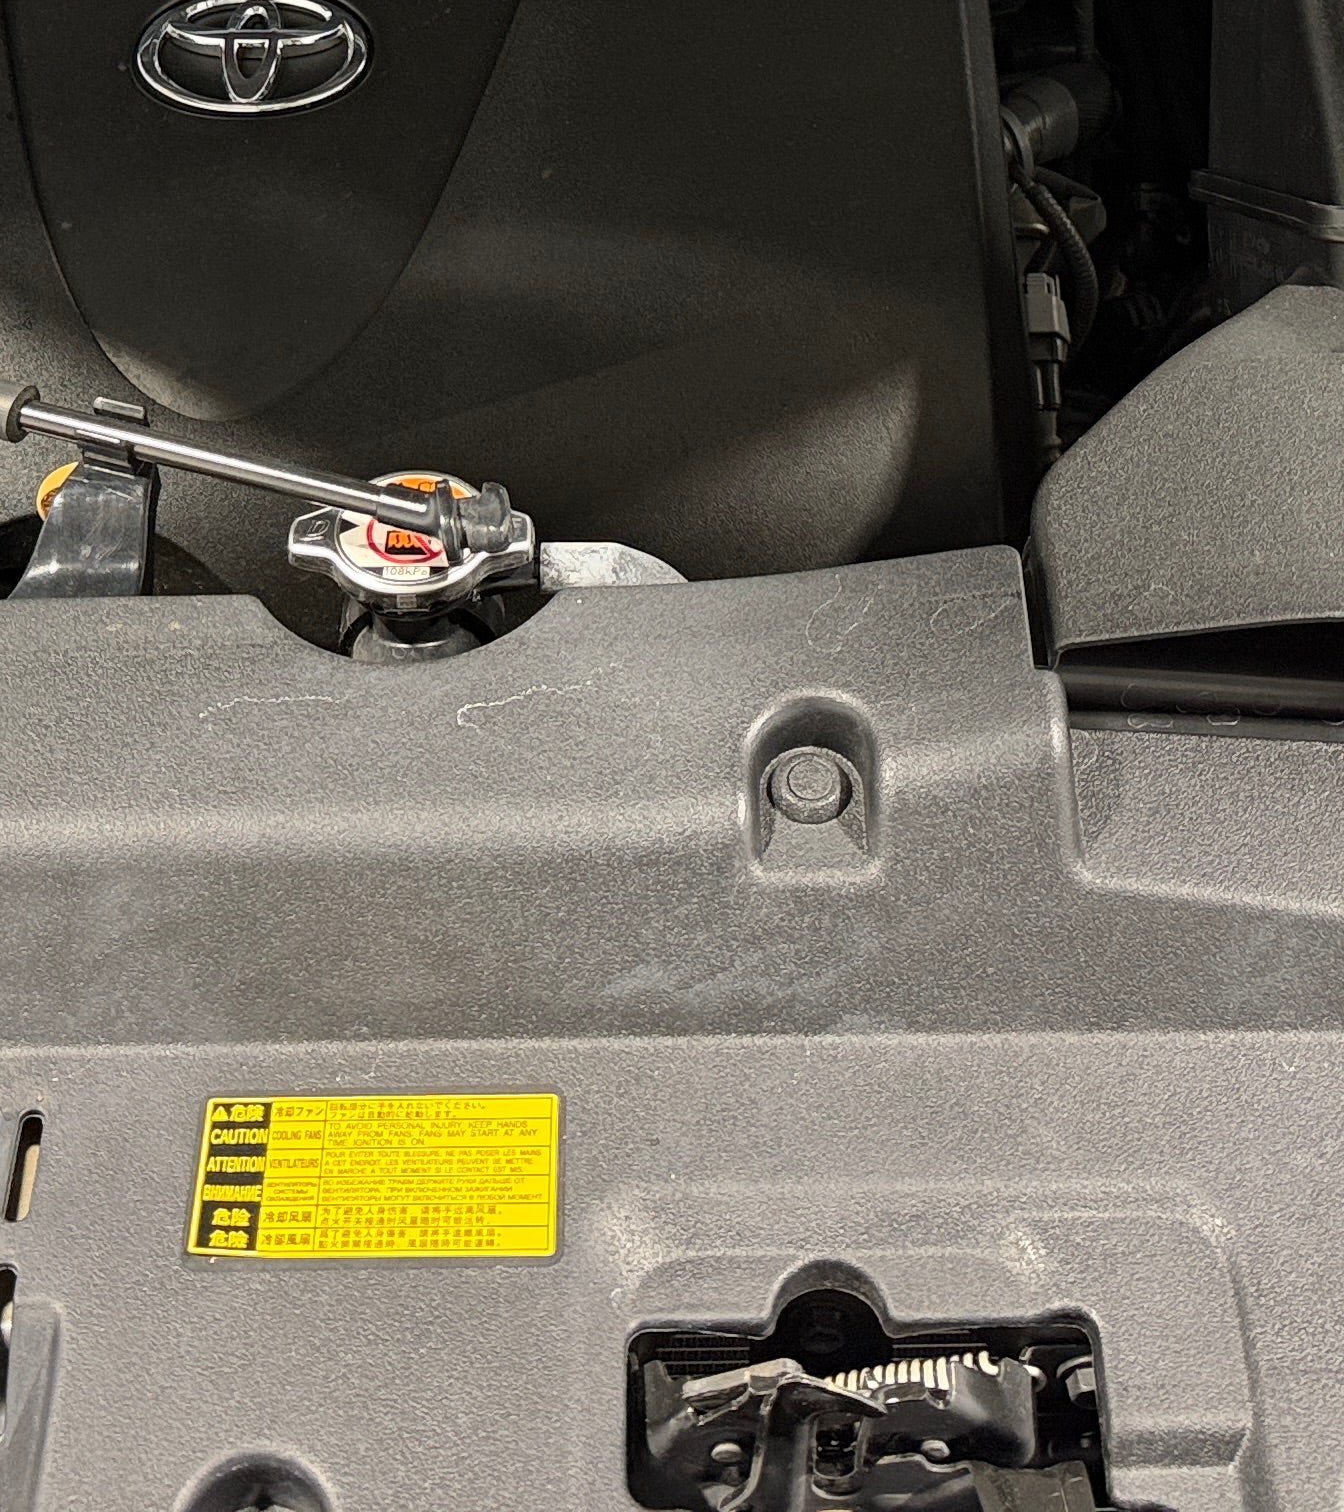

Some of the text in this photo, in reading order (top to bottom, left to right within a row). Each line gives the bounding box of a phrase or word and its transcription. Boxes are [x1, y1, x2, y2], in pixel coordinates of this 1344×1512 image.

[328, 1122, 341, 1131] TO
[345, 1121, 372, 1130] AVOID
[377, 1121, 426, 1130] PERSONAL
[468, 1120, 493, 1129] KEEP
[496, 1120, 528, 1129] HANDS
[210, 1128, 269, 1145] CAUTION
[272, 1129, 322, 1141] COOLING FANS
[327, 1130, 353, 1138] AWAY
[357, 1129, 384, 1138] FROM
[418, 1129, 443, 1138] FANS
[447, 1128, 466, 1137] MAY
[470, 1128, 499, 1137] START
[503, 1128, 514, 1137] AT
[518, 1128, 538, 1136] ANY
[327, 1138, 348, 1146] TIME
[352, 1137, 393, 1146] IGNITION
[397, 1137, 406, 1146] IS
[206, 1156, 266, 1173] ATTENTION
[269, 1158, 320, 1169] VENTILATEURS
[202, 1184, 263, 1202] ВНИМАНИЕ
[211, 1207, 252, 1227] 危险
